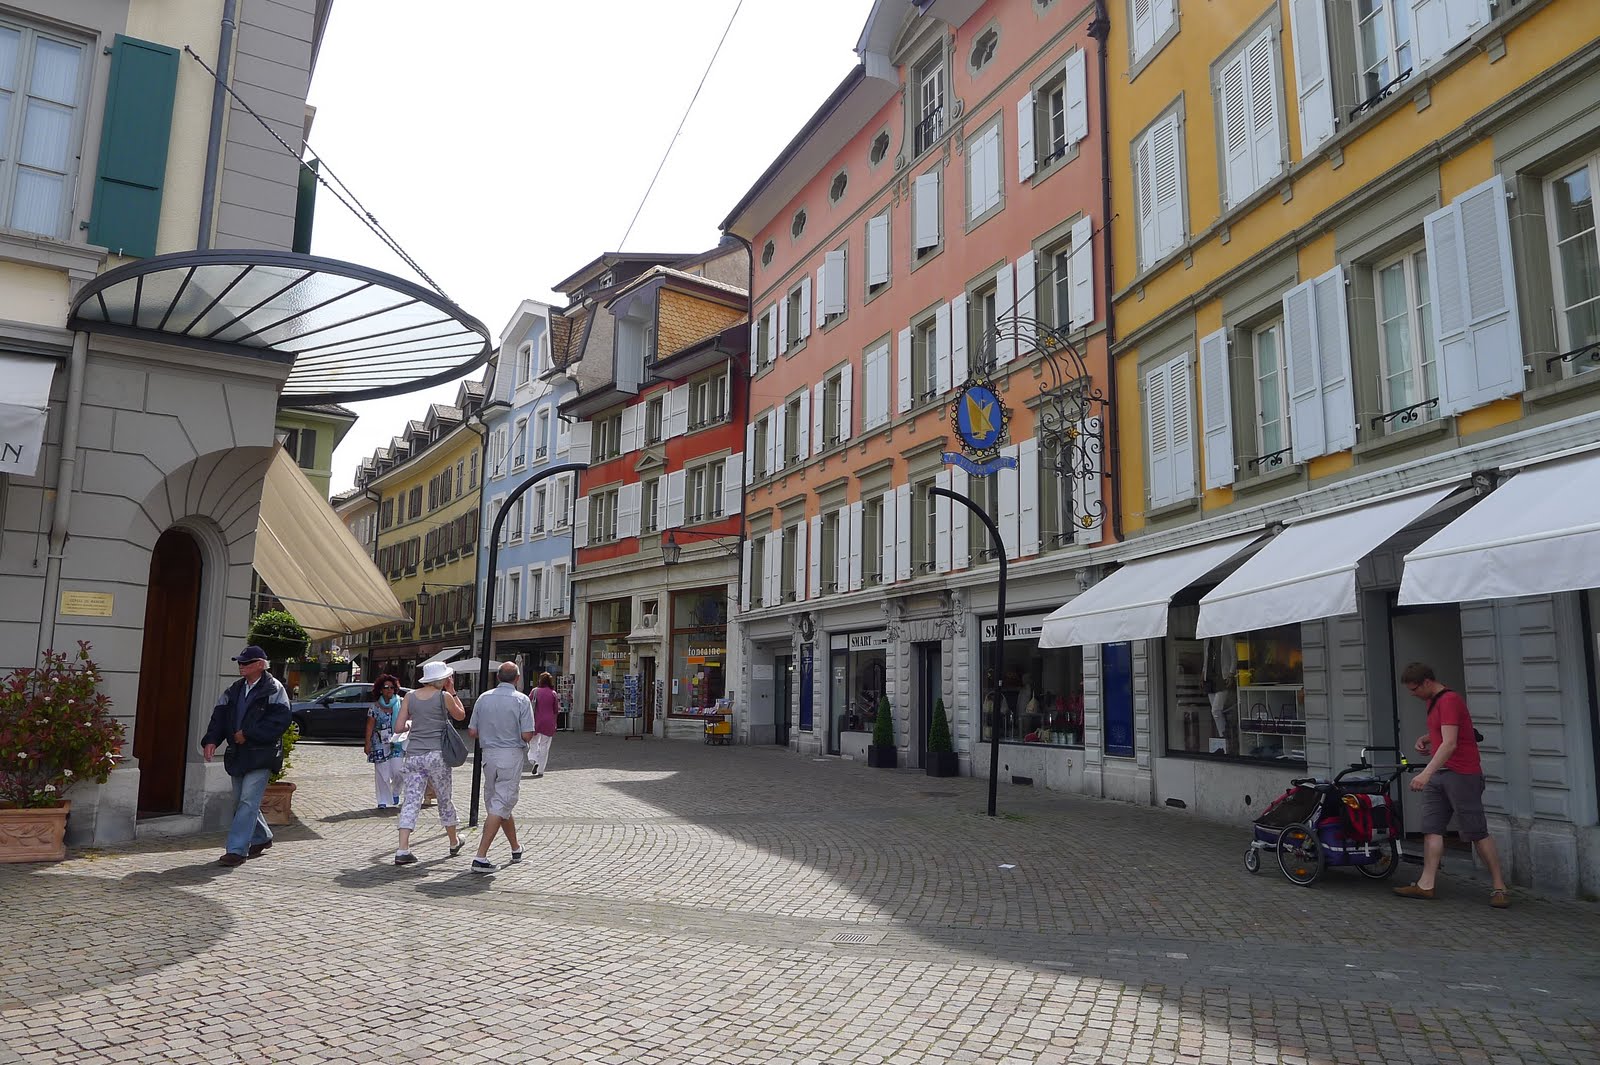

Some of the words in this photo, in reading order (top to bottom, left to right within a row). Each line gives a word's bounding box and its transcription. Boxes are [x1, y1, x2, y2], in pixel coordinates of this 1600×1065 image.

[1, 442, 23, 463] N
[986, 623, 1017, 638] SMRT
[851, 636, 872, 648] SMART
[601, 650, 627, 659] fontaine
[688, 645, 721, 656] fontaine
